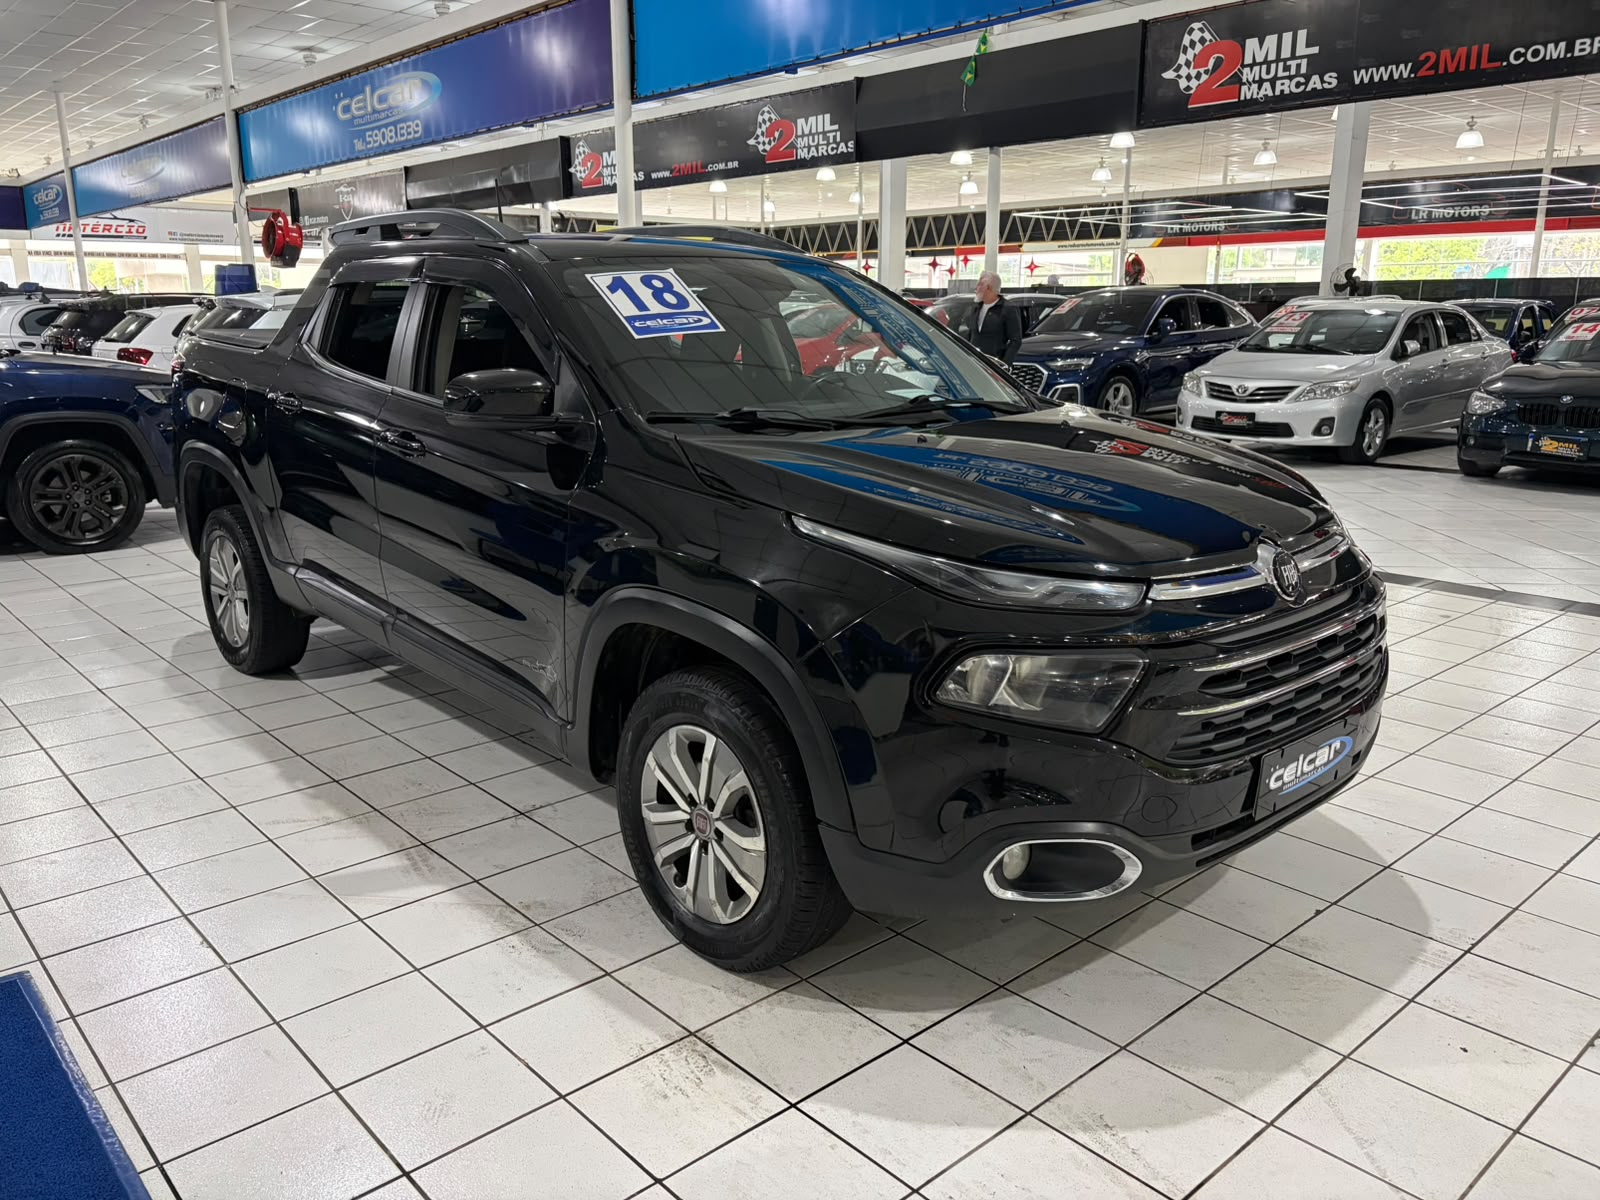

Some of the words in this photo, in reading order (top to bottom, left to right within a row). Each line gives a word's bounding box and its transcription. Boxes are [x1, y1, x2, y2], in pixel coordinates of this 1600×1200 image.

[1188, 40, 1243, 108] 2
[1243, 29, 1320, 64] MIL
[1242, 58, 1308, 82] MULTI
[1240, 72, 1338, 100] MARCAS
[366, 120, 422, 149] 5908.1339
[765, 119, 796, 163] 2
[797, 113, 839, 135] MIL
[798, 131, 841, 148] MULTI
[798, 141, 854, 159] MARCAS
[582, 152, 603, 188] 2
[1411, 208, 1427, 219] LR
[1432, 205, 1490, 218] MOTORS
[1183, 221, 1226, 232] MOTORS
[606, 274, 690, 312] 18
[634, 317, 699, 328] celcar
[1269, 740, 1341, 790] celcar
